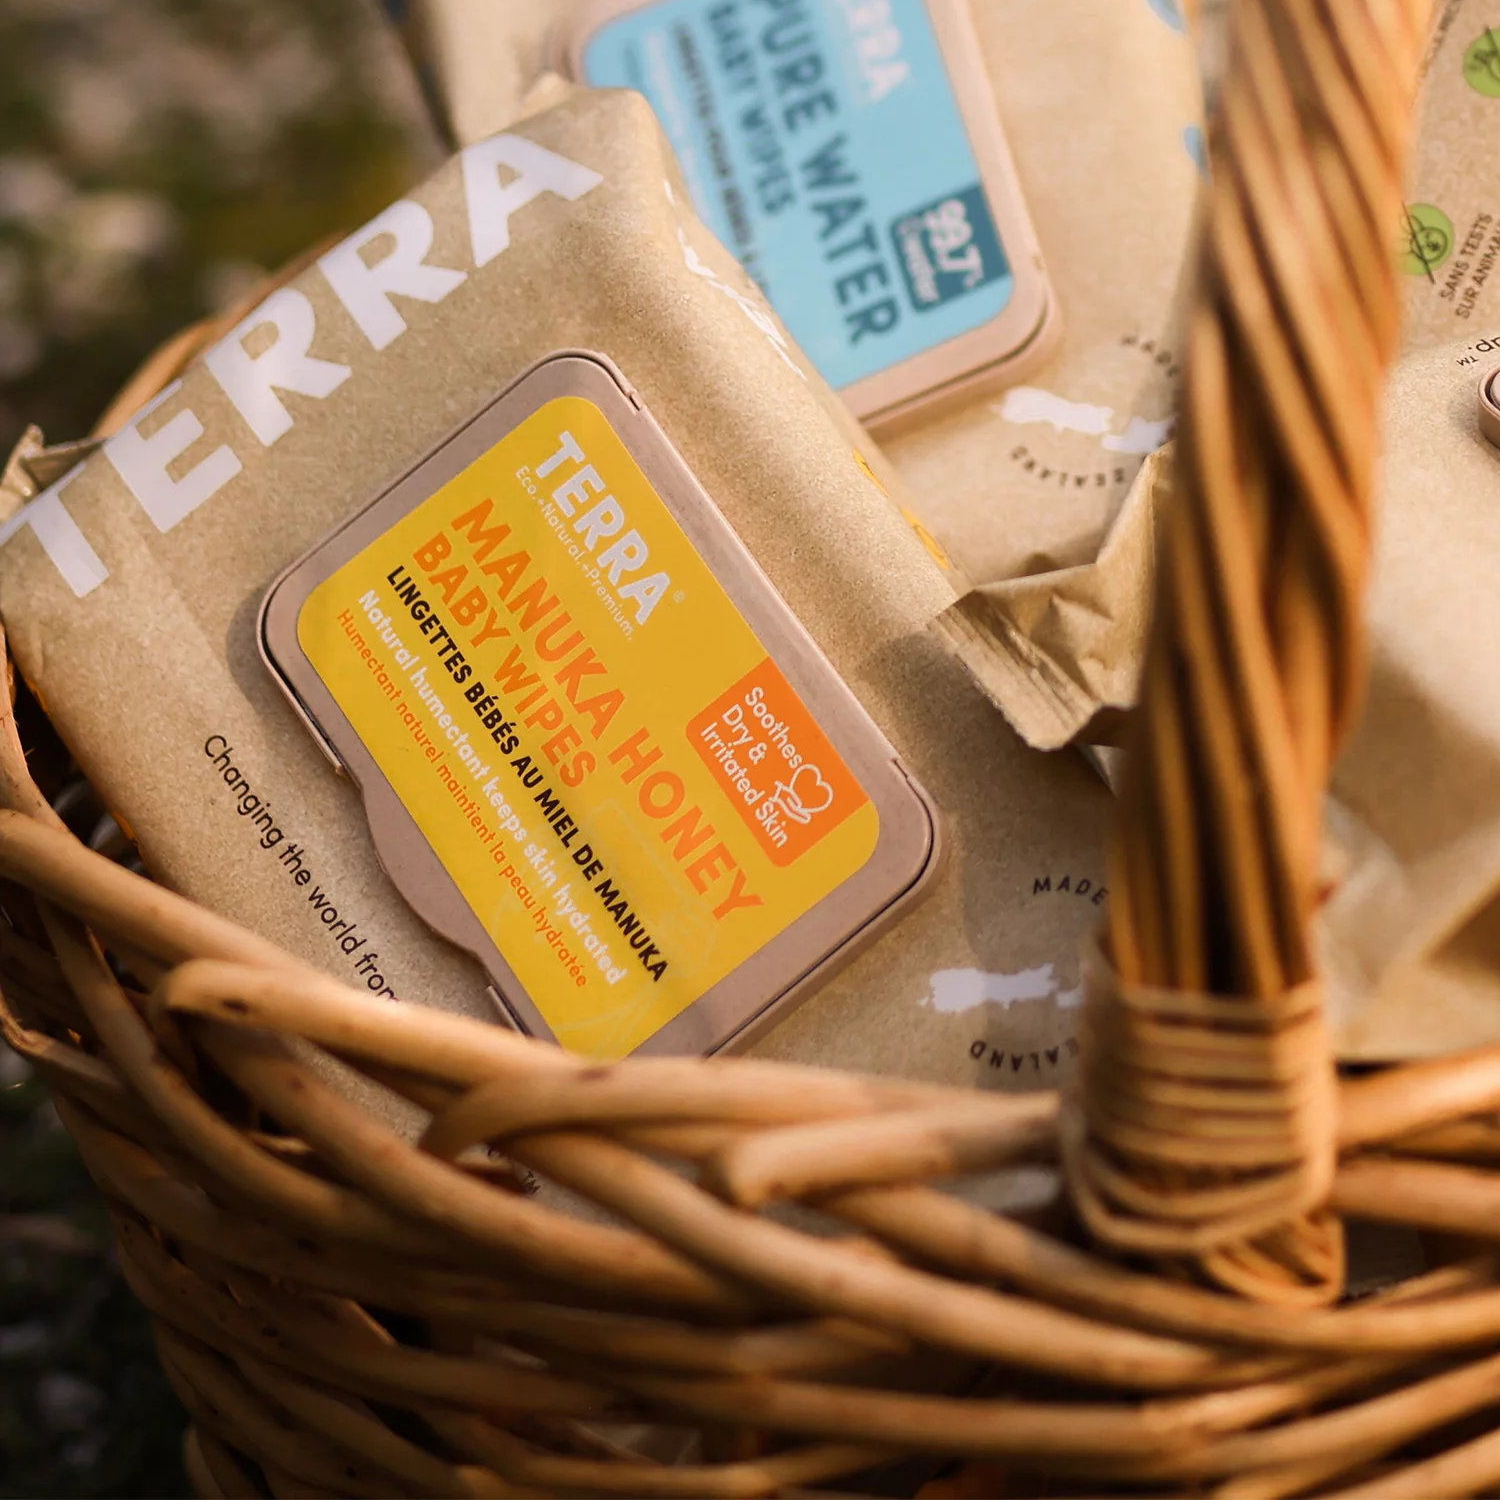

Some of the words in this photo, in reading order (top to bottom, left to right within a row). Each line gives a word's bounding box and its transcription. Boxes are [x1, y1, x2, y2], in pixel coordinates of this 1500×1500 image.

[708, 0, 757, 91] BABY
[736, 103, 798, 217] WIPES
[799, 133, 903, 347] WATER
[1439, 252, 1468, 301] SANS
[1461, 212, 1493, 256] TESTS
[1456, 277, 1482, 320] SUR
[0, 132, 603, 598] TERRA
[413, 532, 510, 648] BABY
[493, 645, 595, 787] WIPES
[451, 498, 625, 740] MANUKA
[608, 727, 765, 920] HONEY
[722, 704, 752, 747] Dry
[748, 741, 768, 765] &
[745, 686, 803, 769] Soothes
[204, 734, 284, 849] Changing
[279, 844, 311, 886] the
[308, 885, 367, 956] world
[337, 608, 403, 701] Humectant
[395, 691, 445, 765] naturel
[436, 758, 497, 845] maintient
[489, 839, 507, 865] la
[499, 862, 536, 910] peau
[531, 905, 588, 988] hydratée
[358, 588, 420, 672] Natural
[409, 666, 491, 781] humectant
[483, 776, 527, 843] keeps
[524, 842, 558, 888] skin
[553, 884, 627, 986] hydrated
[387, 565, 473, 685] LINGETTES
[464, 680, 519, 755] BÉBÉS
[511, 756, 544, 788] AU
[534, 788, 579, 848] MIEL
[572, 843, 604, 882] DE
[595, 878, 669, 982] MANUKA
[700, 722, 765, 806] Irritated
[755, 799, 789, 847] Skin
[1032, 875, 1110, 906] MADE
